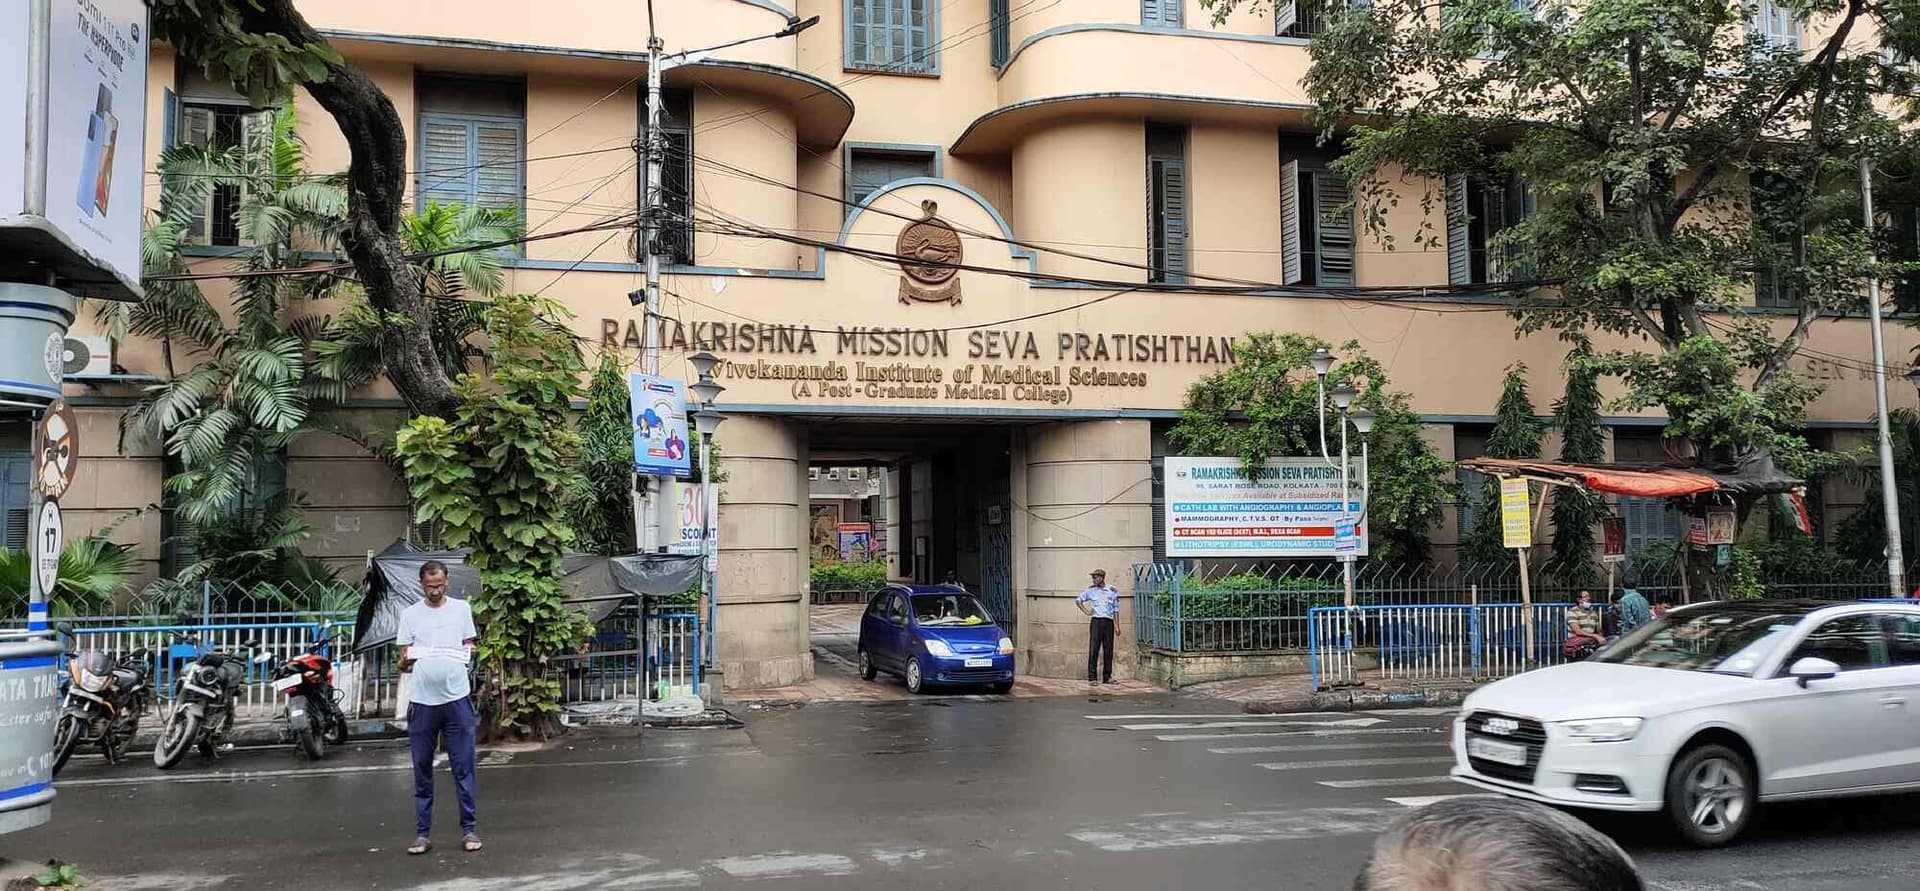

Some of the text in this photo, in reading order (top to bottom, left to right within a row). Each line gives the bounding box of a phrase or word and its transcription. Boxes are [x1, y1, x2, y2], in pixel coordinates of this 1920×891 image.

[78, 12, 89, 37] THE
[837, 325, 948, 357] MISSION
[968, 330, 1040, 360] SEVA
[1058, 332, 1237, 364] PRATISHTHAN
[711, 358, 1147, 387] Vivekananda Institute of Medical Sciences
[791, 382, 812, 400] (A
[820, 382, 852, 398] Post
[864, 382, 938, 399] Graduate
[945, 384, 1007, 401] Medical
[1012, 385, 1073, 404] College)
[1282, 467, 1301, 480] SEVA
[45, 527, 57, 553] 17
